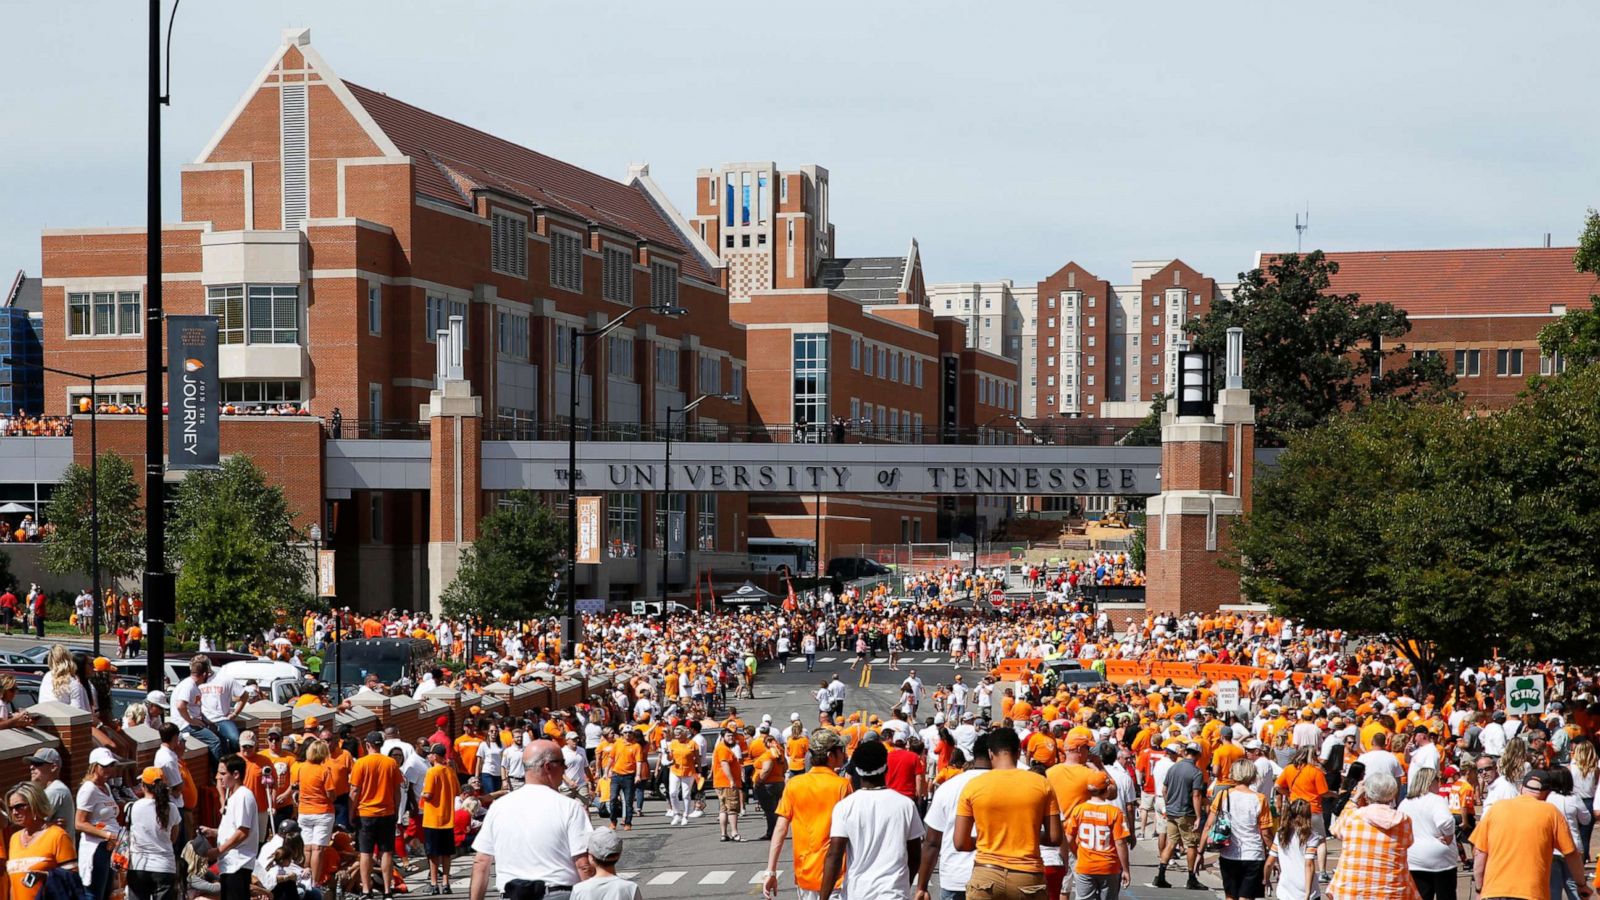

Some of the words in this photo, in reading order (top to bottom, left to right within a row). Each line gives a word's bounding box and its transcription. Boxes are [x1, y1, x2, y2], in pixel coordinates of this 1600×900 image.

[183, 374, 198, 455] JOURNEY
[609, 464, 848, 487] UNVERSITY
[878, 467, 899, 487] of
[927, 467, 1136, 488] TENNESSEE
[990, 594, 1005, 602] STOP
[1511, 689, 1539, 701] TIM
